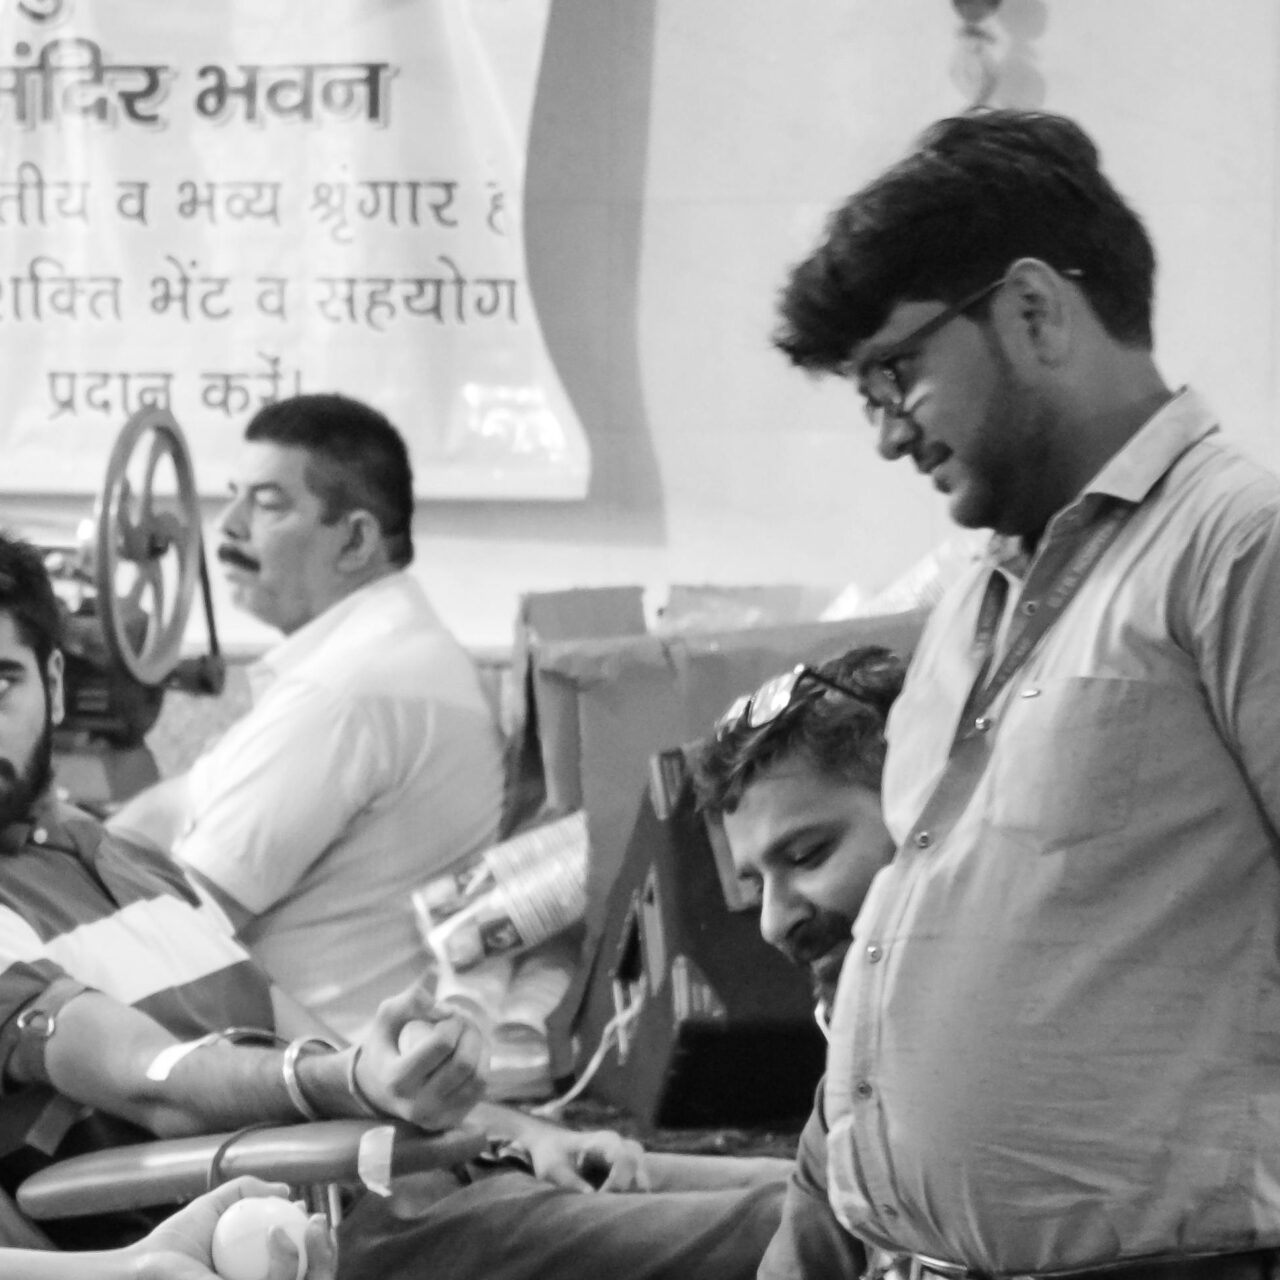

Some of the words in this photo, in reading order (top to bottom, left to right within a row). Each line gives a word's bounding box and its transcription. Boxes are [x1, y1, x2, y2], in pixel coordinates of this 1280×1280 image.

[194, 62, 392, 124] भवन
[115, 179, 150, 228] व
[177, 179, 283, 227] भव्य
[150, 254, 233, 323] भेंट
[254, 277, 289, 323] व
[314, 254, 518, 332] सहयोग
[47, 371, 174, 420] प्रदान
